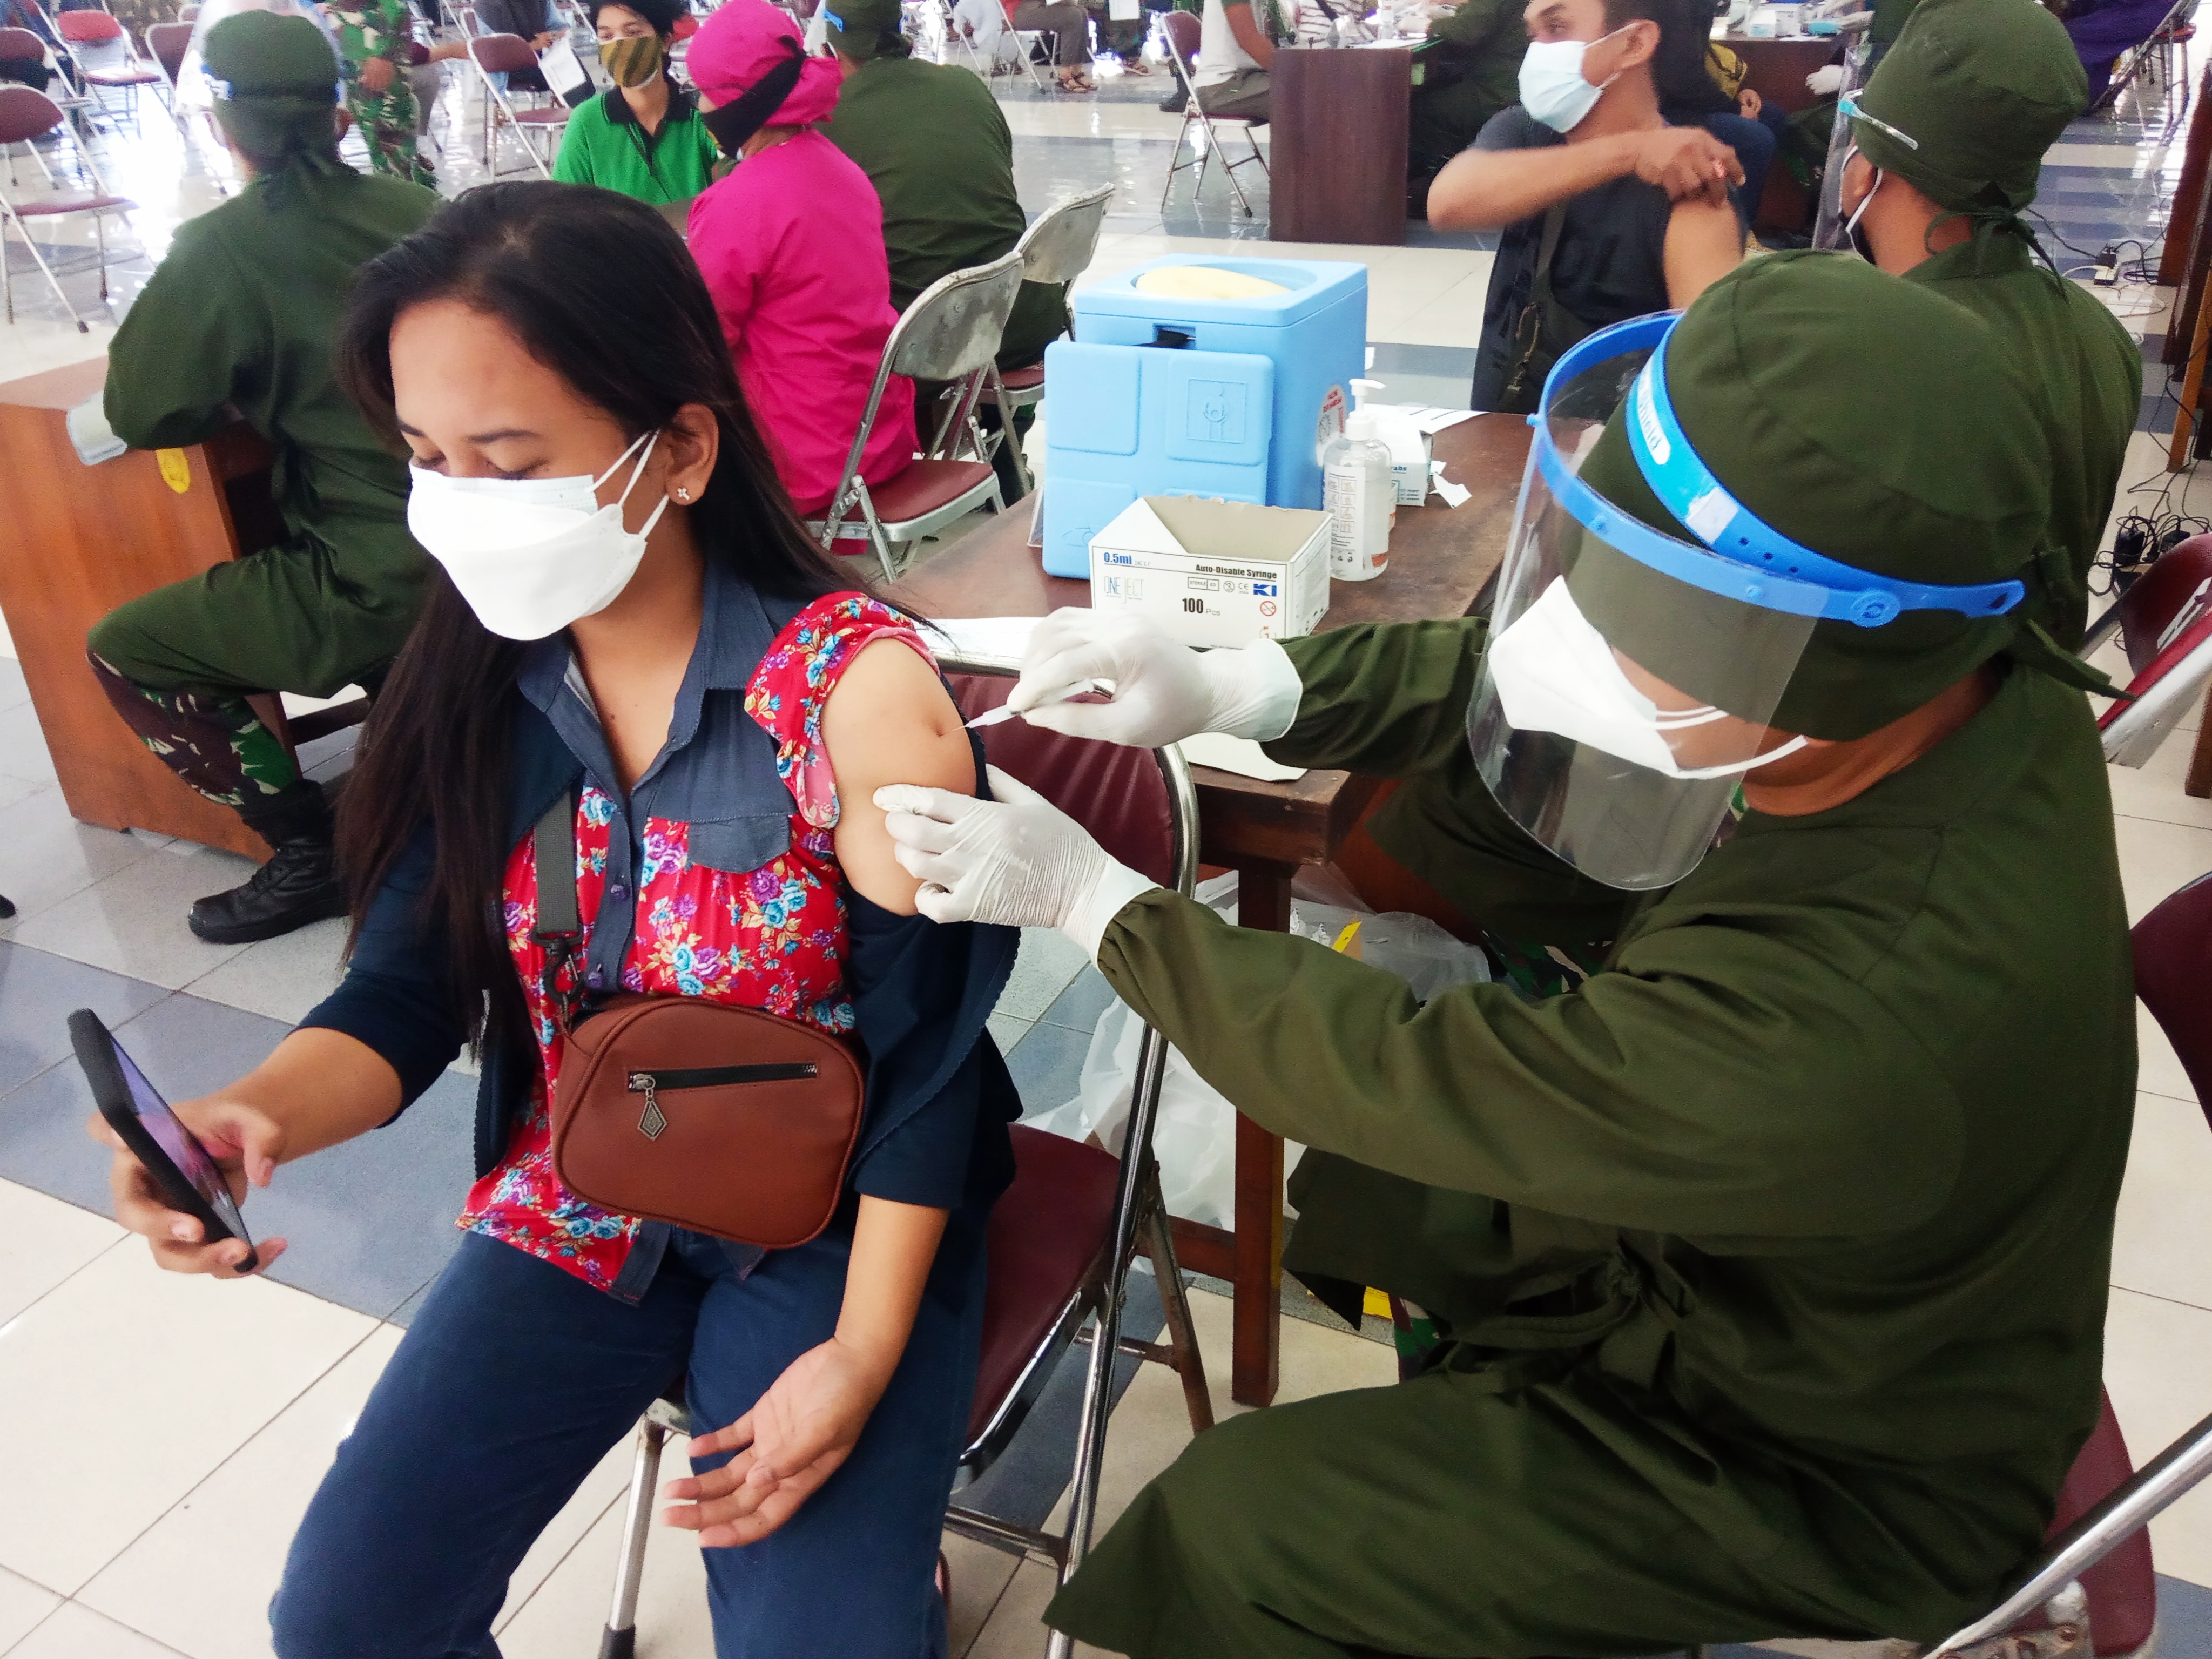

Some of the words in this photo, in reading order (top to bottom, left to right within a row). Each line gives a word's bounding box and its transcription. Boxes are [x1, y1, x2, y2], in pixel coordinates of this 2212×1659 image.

[1103, 552, 1132, 565] 0.5ml
[1196, 564, 1245, 576] Auto-Disable
[1247, 569, 1277, 579] Syringe
[1182, 597, 1204, 614] 100
[1205, 608, 1221, 616] Pcs
